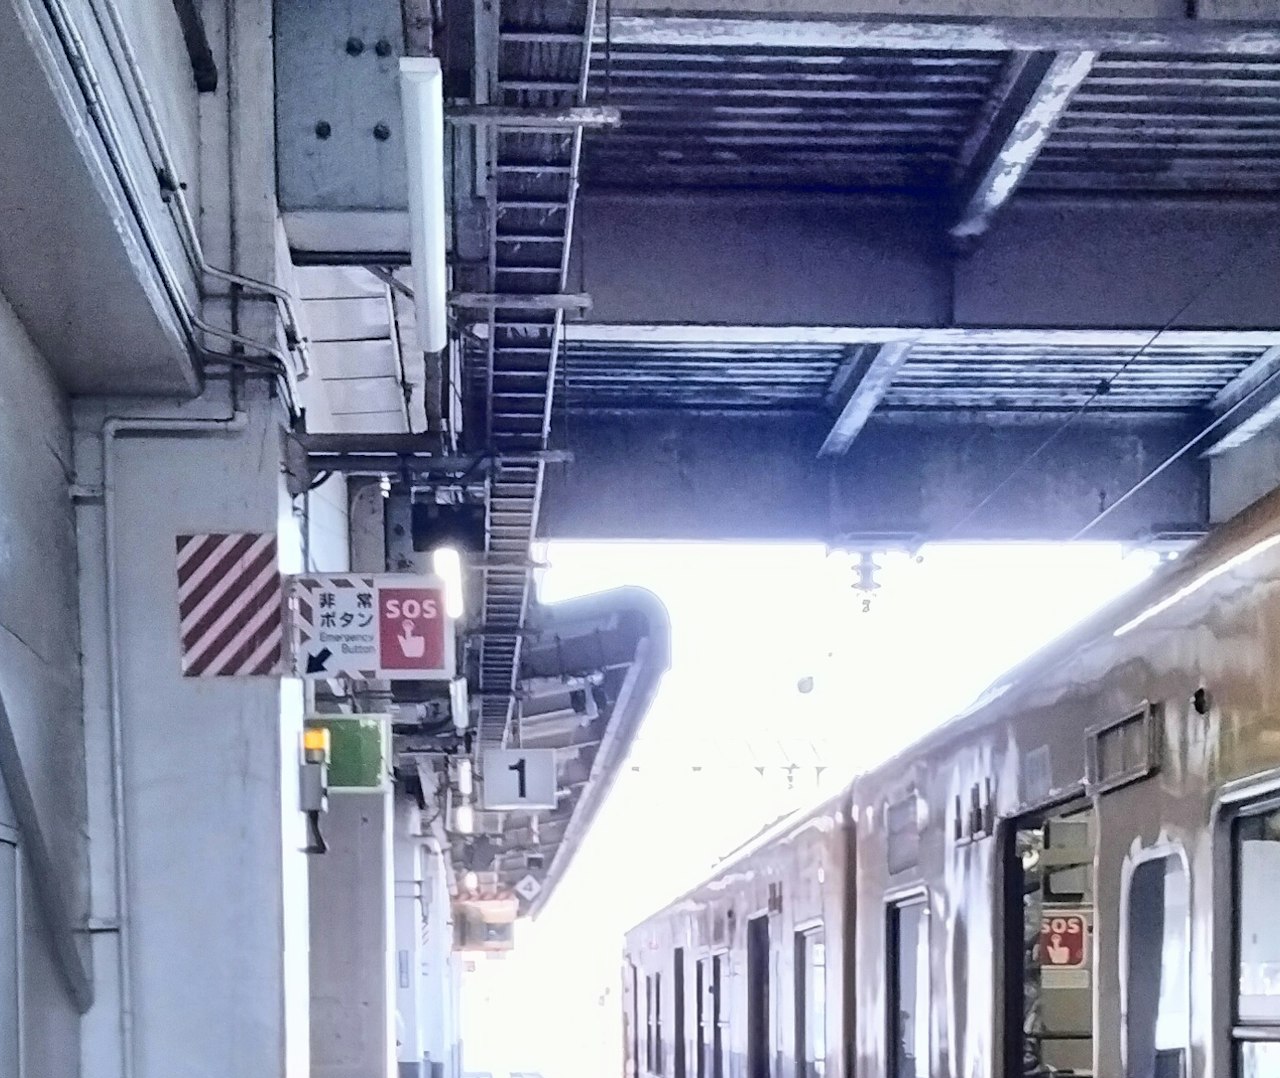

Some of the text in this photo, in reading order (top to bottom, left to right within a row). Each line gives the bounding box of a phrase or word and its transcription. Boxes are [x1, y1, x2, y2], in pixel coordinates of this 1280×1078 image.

[386, 599, 437, 618] SOS
[320, 611, 373, 628] ボタン
[319, 632, 374, 642] Emergency
[341, 643, 376, 654] Button
[508, 758, 526, 798] 1
[1041, 918, 1080, 933] SOS
